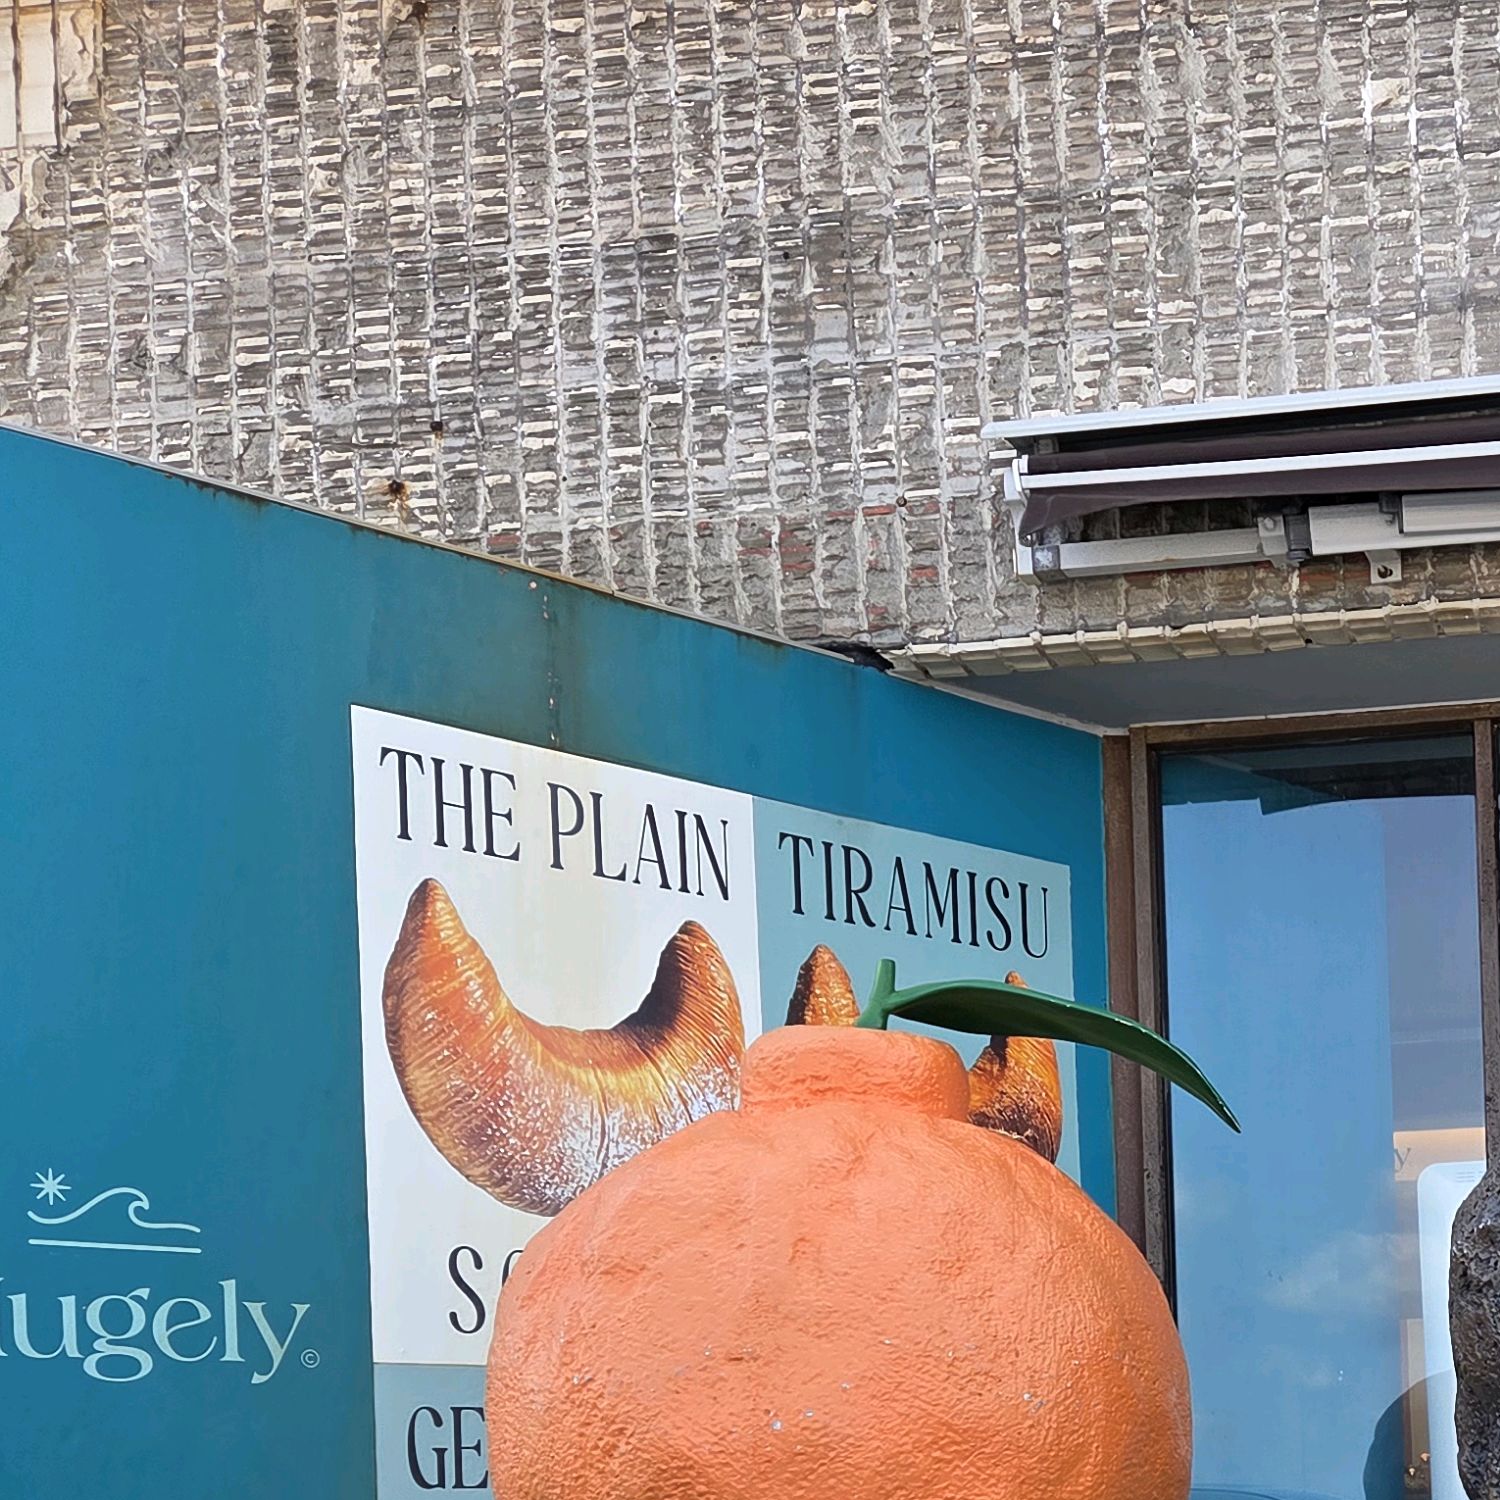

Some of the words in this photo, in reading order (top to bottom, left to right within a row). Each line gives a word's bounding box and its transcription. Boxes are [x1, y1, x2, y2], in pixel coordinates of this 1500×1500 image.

[379, 746, 521, 861] THE
[546, 783, 730, 901] PLAIN
[779, 832, 1048, 959] TIRAMISU
[0, 1276, 311, 1386] ugely
[448, 1245, 525, 1334] S
